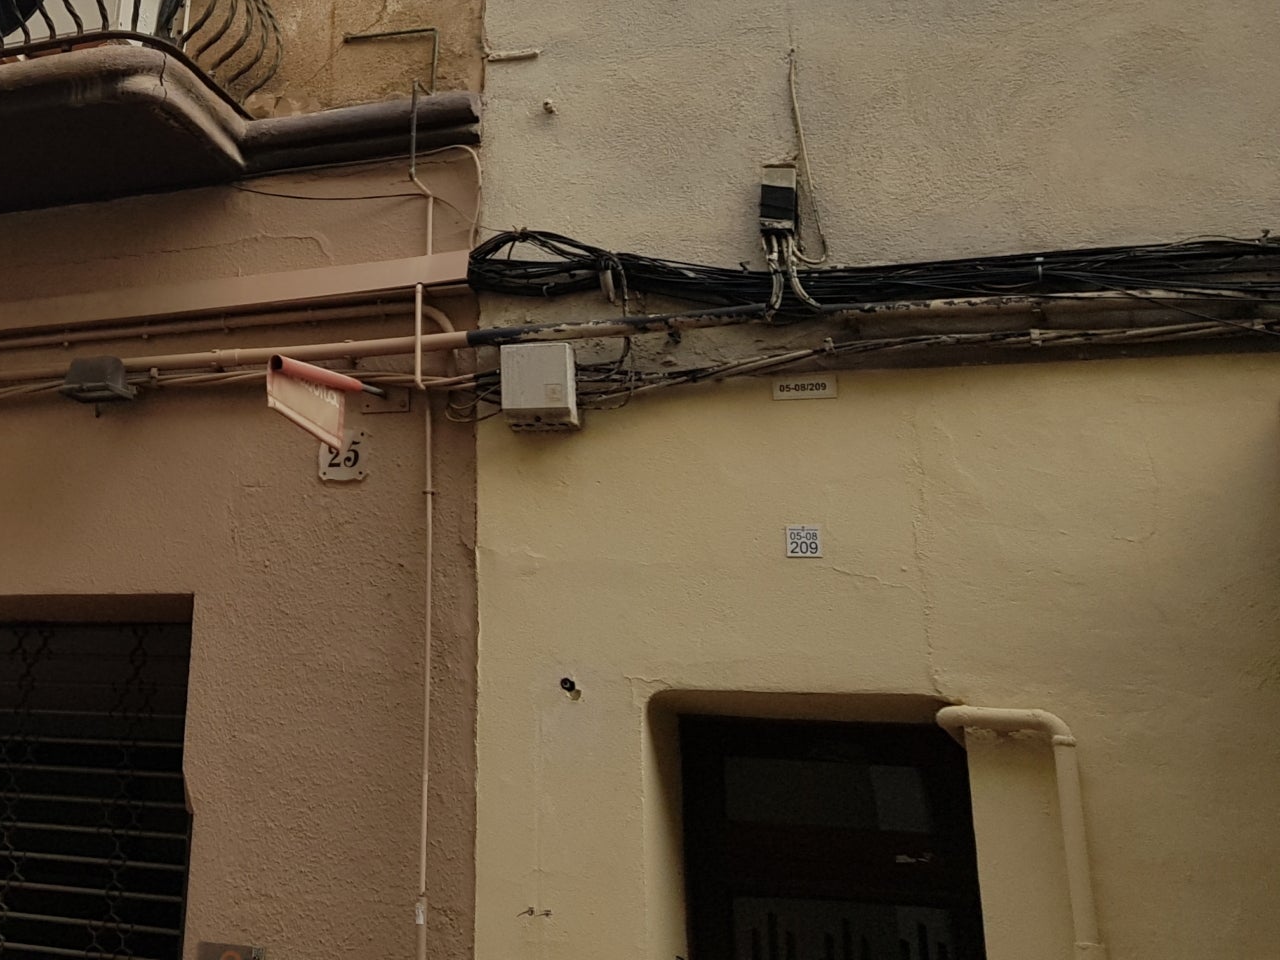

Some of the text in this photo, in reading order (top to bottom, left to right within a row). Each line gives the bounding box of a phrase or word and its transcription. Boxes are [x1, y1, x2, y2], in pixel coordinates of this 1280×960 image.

[779, 382, 827, 392] 05-08/209
[327, 440, 361, 468] 25
[790, 532, 818, 541] 05-08
[790, 541, 818, 554] 209
